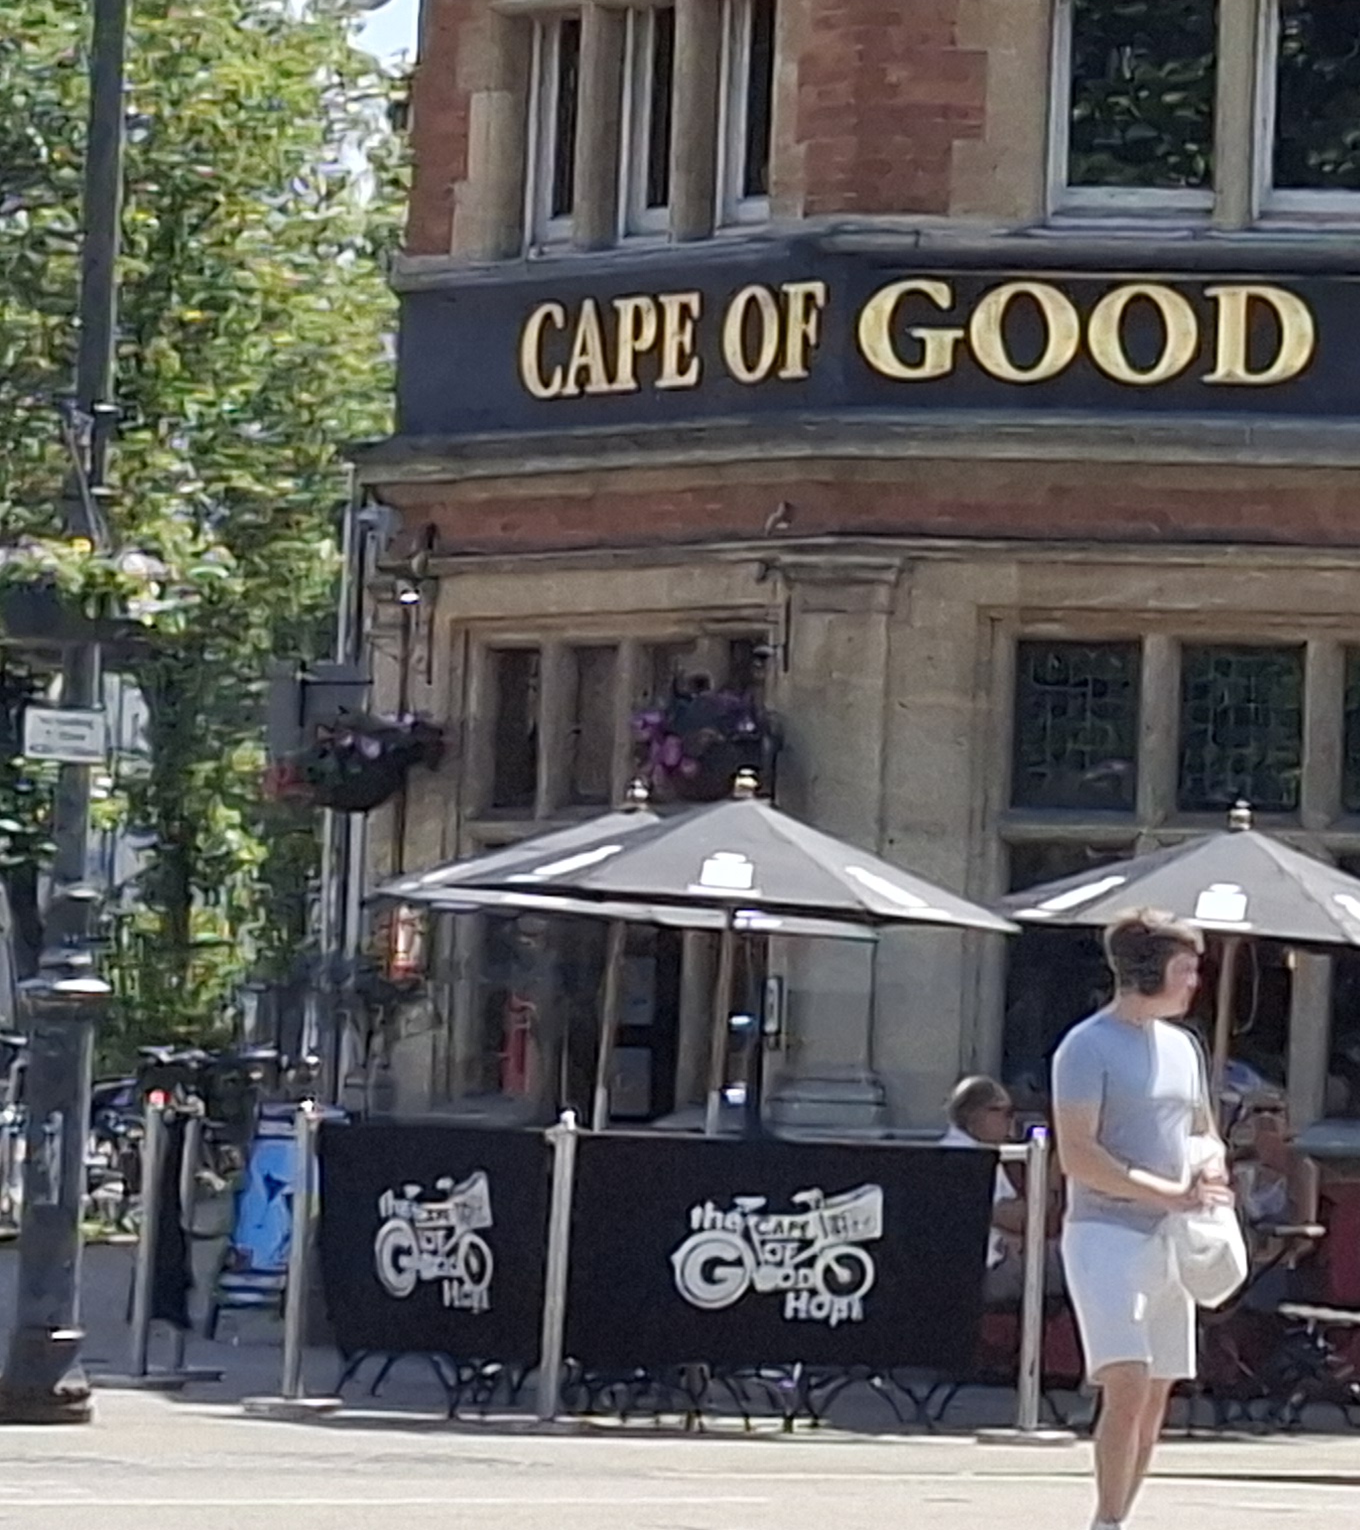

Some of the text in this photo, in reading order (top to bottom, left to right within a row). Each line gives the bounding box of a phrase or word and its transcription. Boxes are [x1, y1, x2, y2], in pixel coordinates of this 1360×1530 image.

[521, 292, 700, 398] CAPE
[722, 281, 826, 384] OF
[858, 278, 1315, 384] GOOD
